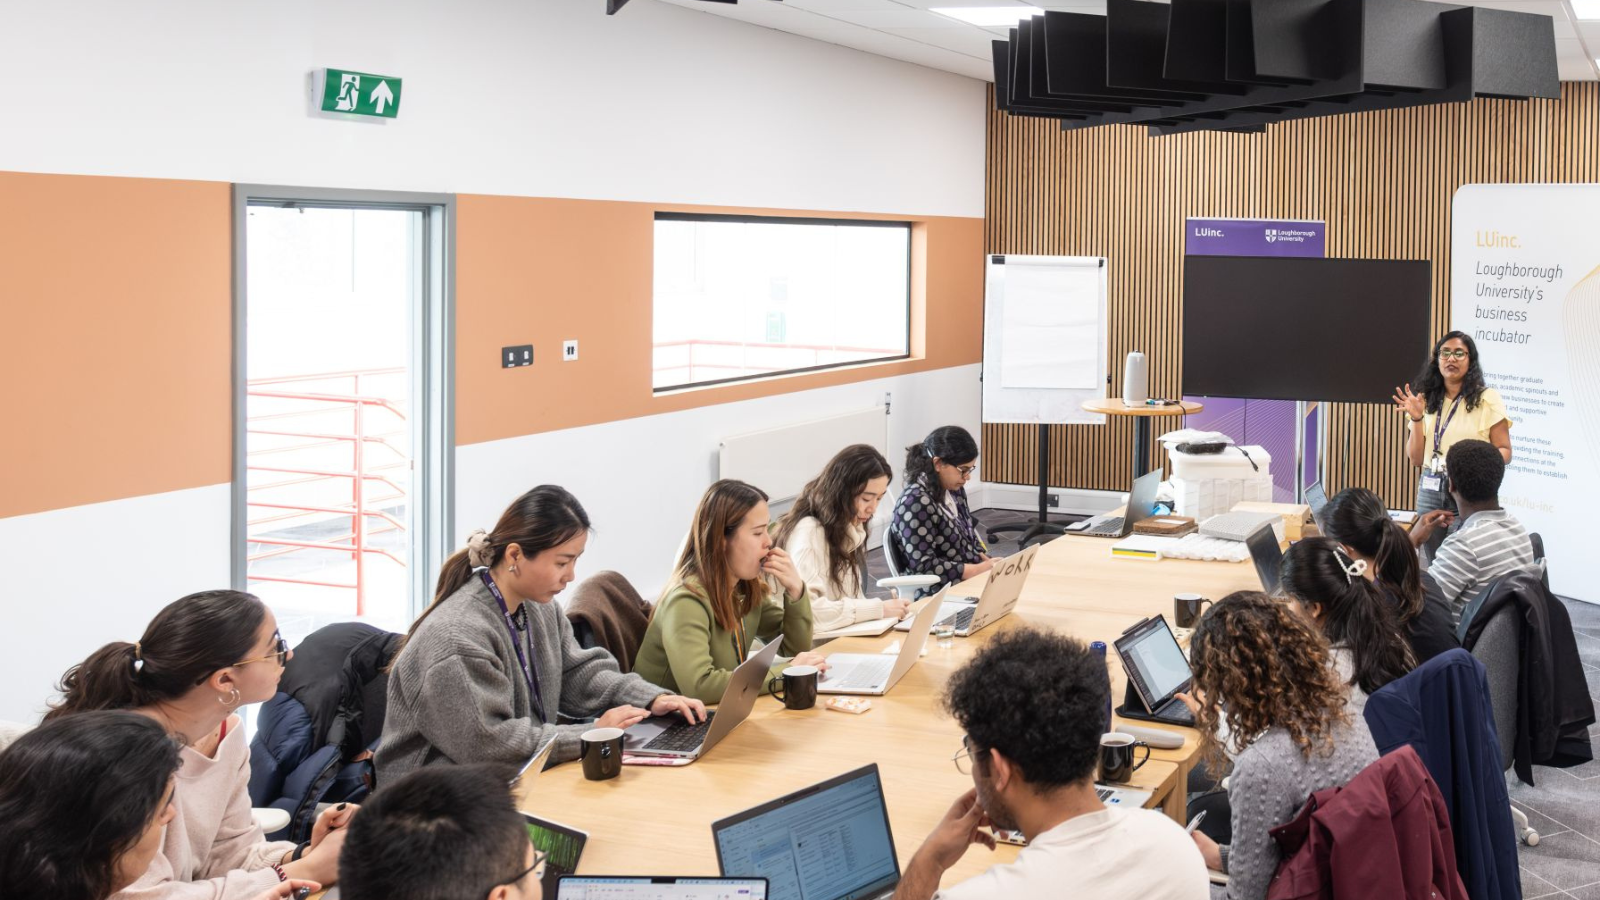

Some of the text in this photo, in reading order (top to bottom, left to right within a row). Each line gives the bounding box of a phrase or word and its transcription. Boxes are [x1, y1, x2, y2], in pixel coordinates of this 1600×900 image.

[1195, 228, 1224, 237] LUinc.
[1476, 231, 1521, 248] LUinc.
[1475, 260, 1564, 283] Loughborough
[1475, 282, 1544, 304] University's
[1475, 304, 1528, 322] business
[1474, 326, 1532, 345] incubator
[1497, 373, 1520, 382] together
[1520, 376, 1544, 385] graduate
[1499, 384, 1524, 392] academic
[1548, 389, 1559, 397] and
[1511, 395, 1540, 405] businesses
[1519, 407, 1547, 416] supportive
[1515, 435, 1536, 444] nurture
[1536, 438, 1552, 446] these
[1512, 445, 1532, 454] roviding
[1532, 447, 1542, 455] the
[1546, 460, 1556, 468] the
[1505, 464, 1568, 480] abling them to establish
